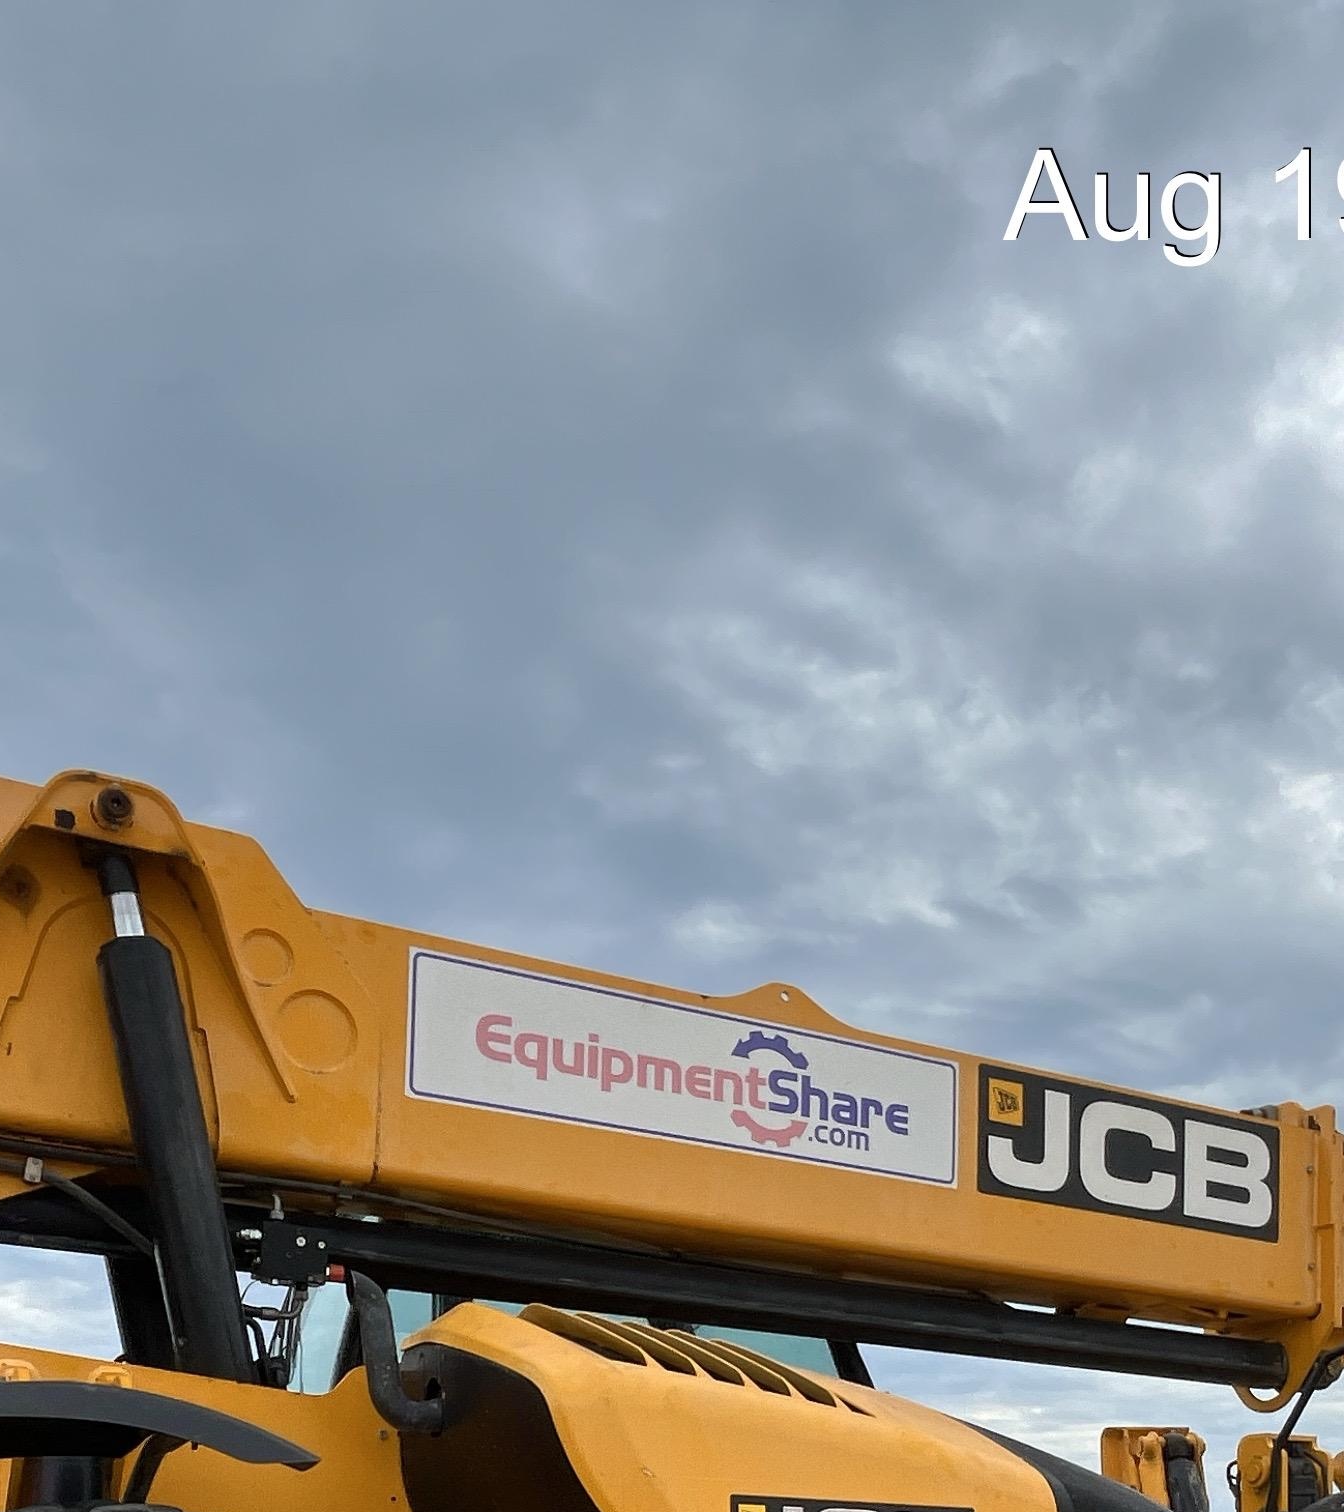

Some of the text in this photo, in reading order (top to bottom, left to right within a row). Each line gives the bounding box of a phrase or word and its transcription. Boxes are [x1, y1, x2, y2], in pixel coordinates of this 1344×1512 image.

[474, 1012, 910, 1136] EquipmentShare
[807, 1120, 871, 1152] .com
[987, 1089, 1272, 1227] JCB
